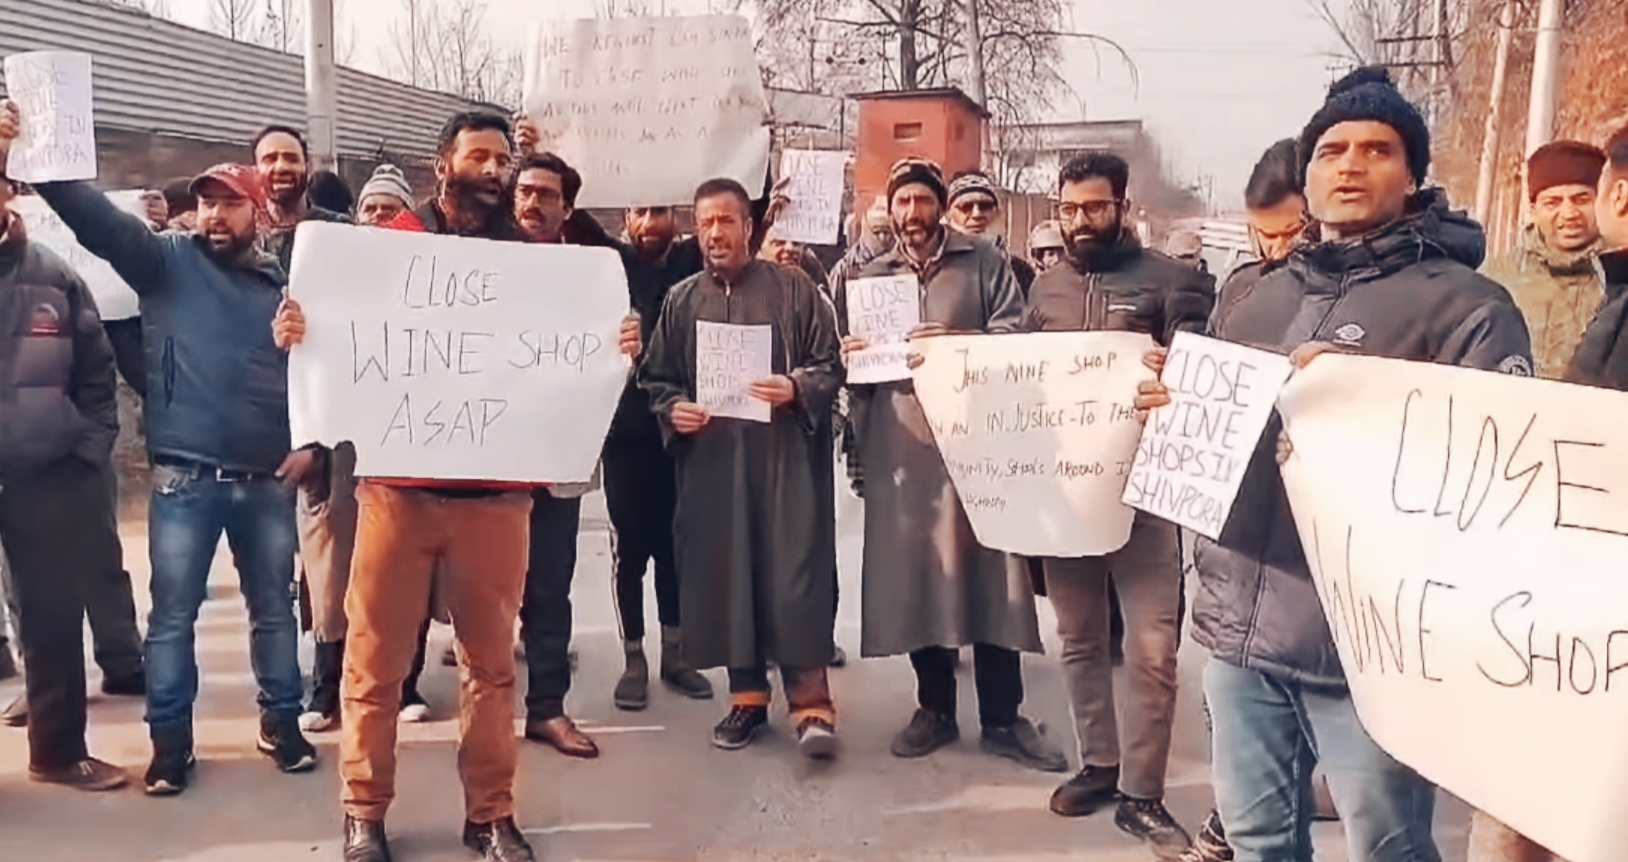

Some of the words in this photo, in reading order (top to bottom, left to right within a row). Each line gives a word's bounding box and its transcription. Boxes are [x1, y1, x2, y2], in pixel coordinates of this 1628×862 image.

[402, 255, 498, 308] CLOSE
[351, 320, 494, 384] WINE
[507, 331, 602, 371] SHOP
[1066, 352, 1118, 375] SHOP
[380, 392, 509, 447] ASAP
[1155, 400, 1243, 449] WINE
[1138, 438, 1206, 476] SHOPS
[1391, 387, 1628, 537] CLOSE
[1313, 518, 1459, 683] WINE
